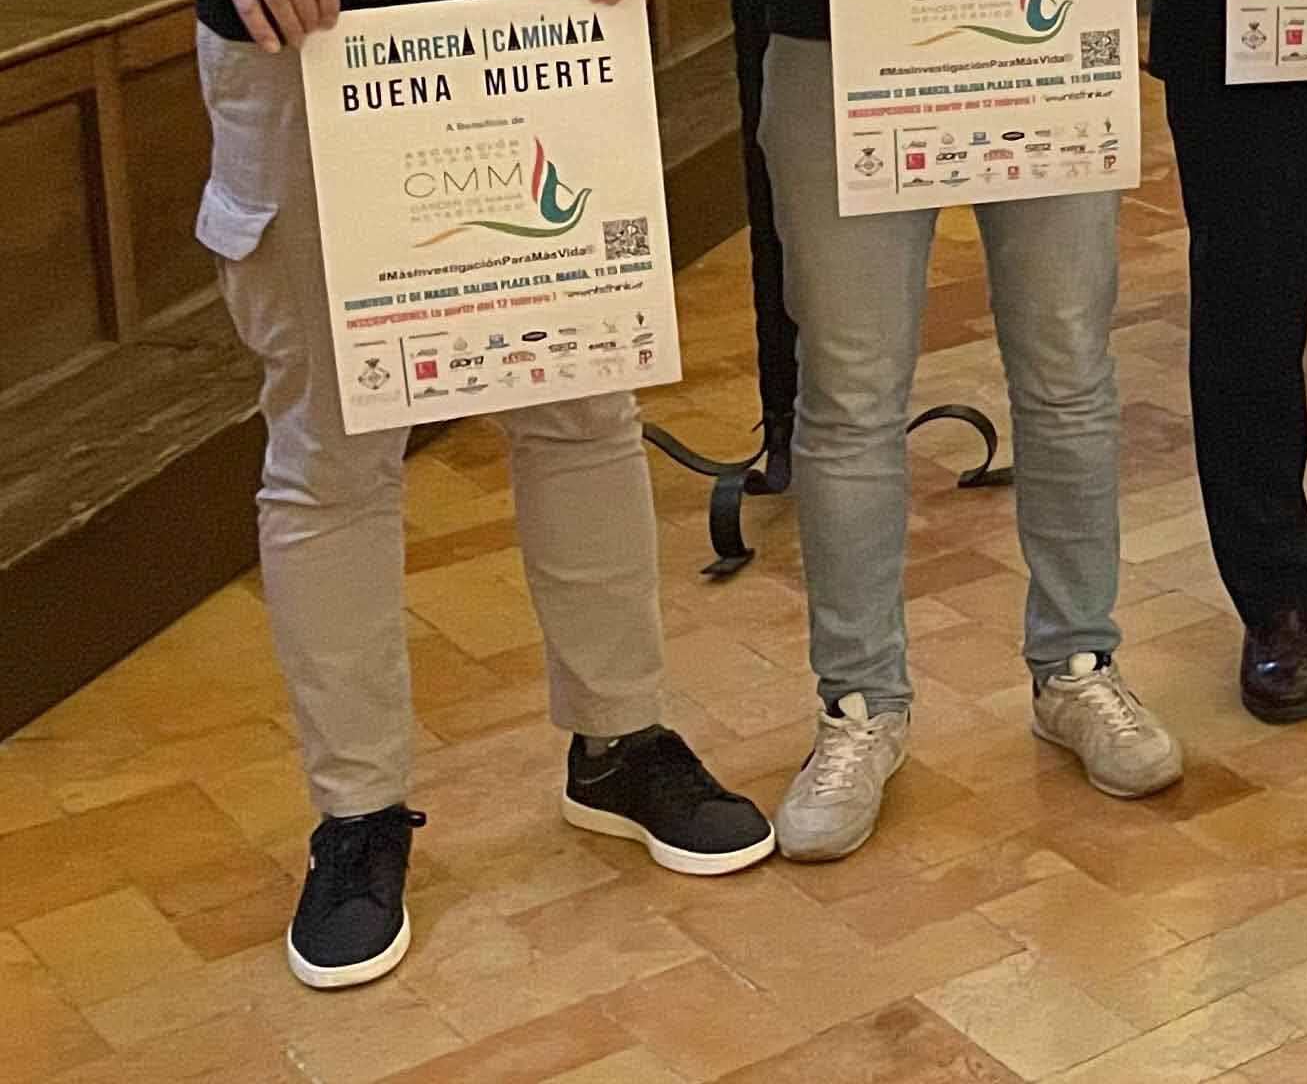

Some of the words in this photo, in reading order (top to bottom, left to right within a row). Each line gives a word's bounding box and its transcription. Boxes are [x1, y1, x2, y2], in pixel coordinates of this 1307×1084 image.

[373, 25, 475, 66] CARRERA
[342, 74, 452, 112] BUENA
[484, 56, 613, 96] MUERTE
[404, 162, 523, 198] CMM
